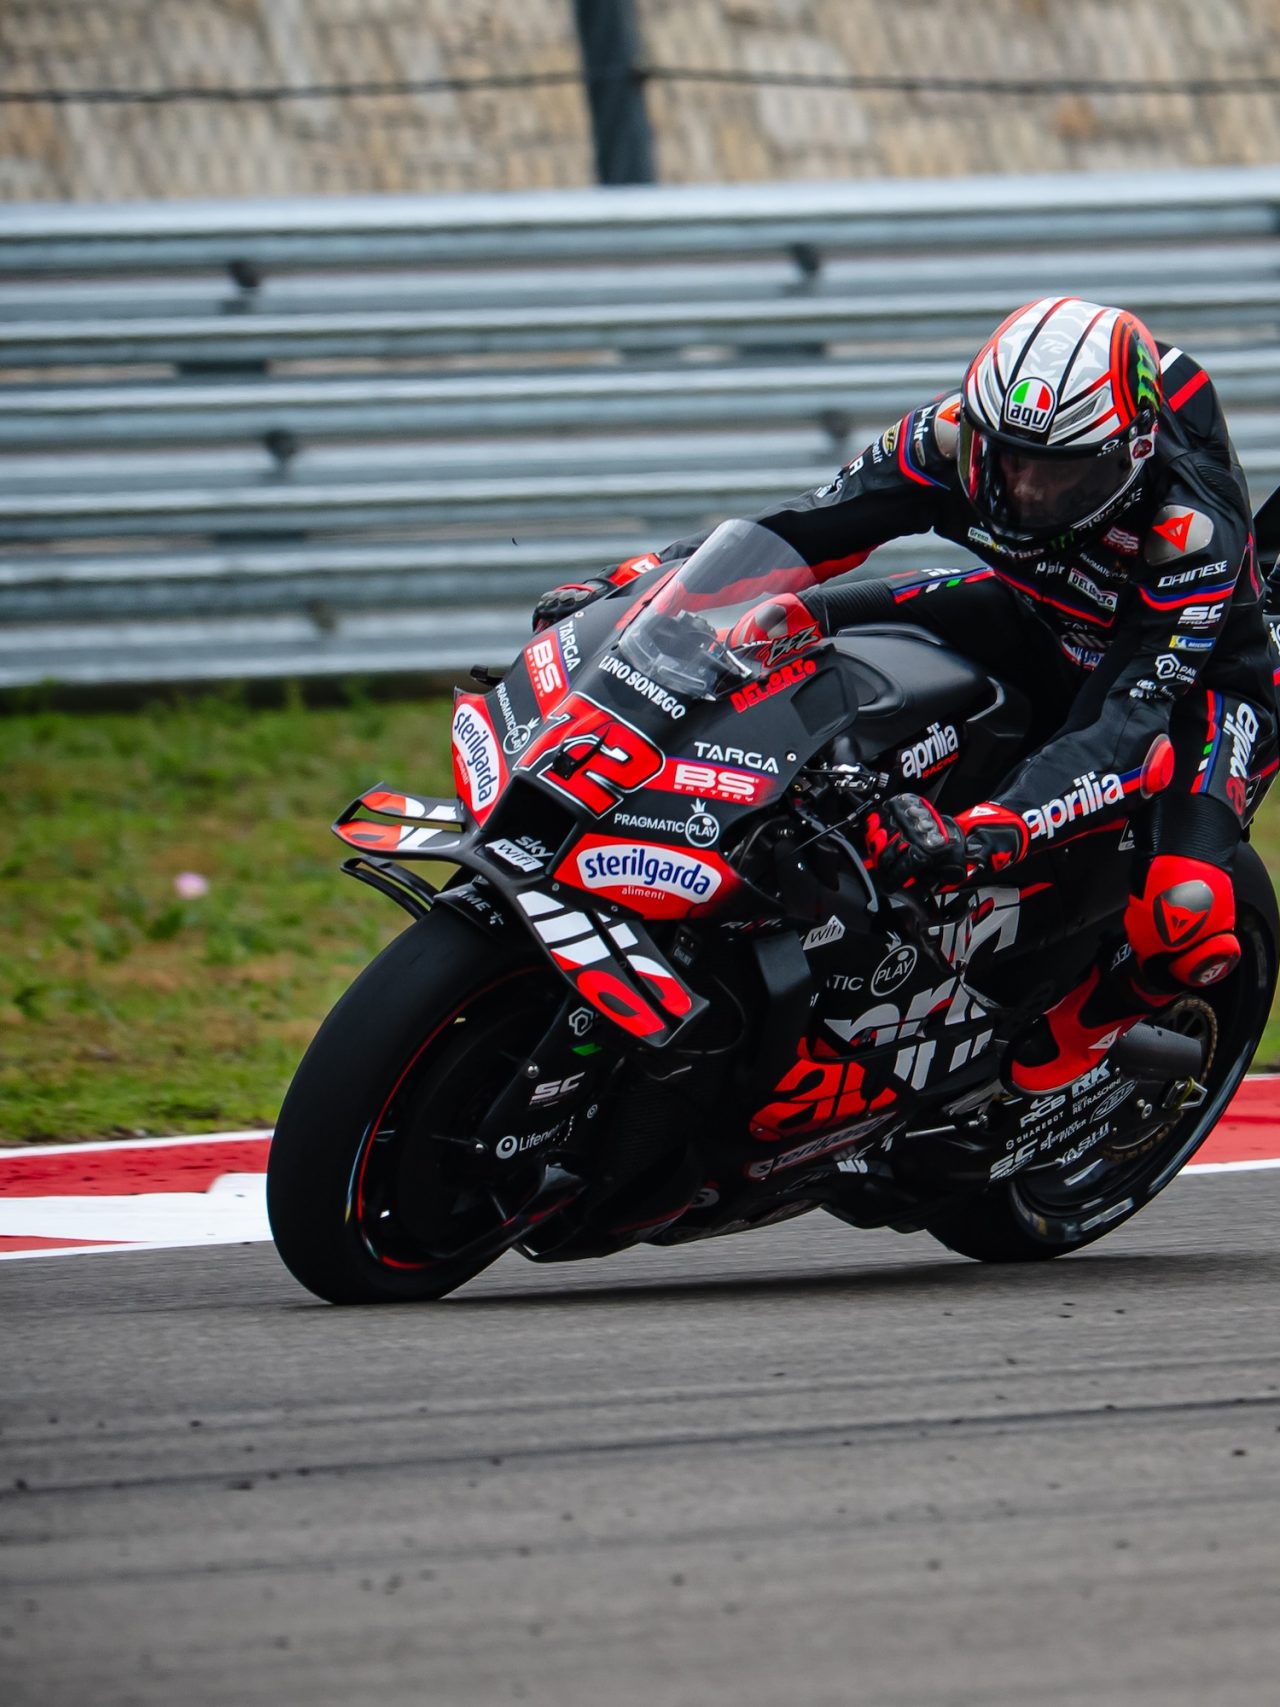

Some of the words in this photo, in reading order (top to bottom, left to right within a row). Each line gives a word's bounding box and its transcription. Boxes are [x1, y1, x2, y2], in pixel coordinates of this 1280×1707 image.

[1009, 402, 1046, 427] agv
[1158, 560, 1228, 588] DAINESE
[1180, 603, 1224, 621] SC
[559, 620, 581, 672] TARGA
[533, 639, 563, 693] BS
[598, 656, 631, 684] LINO
[625, 671, 687, 720] SONEGO
[496, 682, 516, 732] PRAGMATIC
[454, 711, 497, 803] sterilgarda
[512, 691, 666, 819] 72
[694, 741, 779, 774] TARGA
[901, 721, 958, 779] aprilia
[674, 764, 757, 796] BS
[1021, 770, 1125, 840] aprilia
[614, 812, 686, 834] PRAGMATIC
[689, 822, 716, 838] PLAY
[498, 843, 536, 867] wifi
[515, 835, 555, 858] sky
[584, 848, 711, 896] sterilgarda
[621, 885, 666, 901] alimenti
[874, 960, 912, 985] PLAY
[529, 1071, 585, 1105] SC
[1072, 1058, 1111, 1098] RK
[1016, 1111, 1064, 1143] SHAREBOT
[1020, 1094, 1066, 1128] RCB
[990, 1138, 1038, 1179] SC
